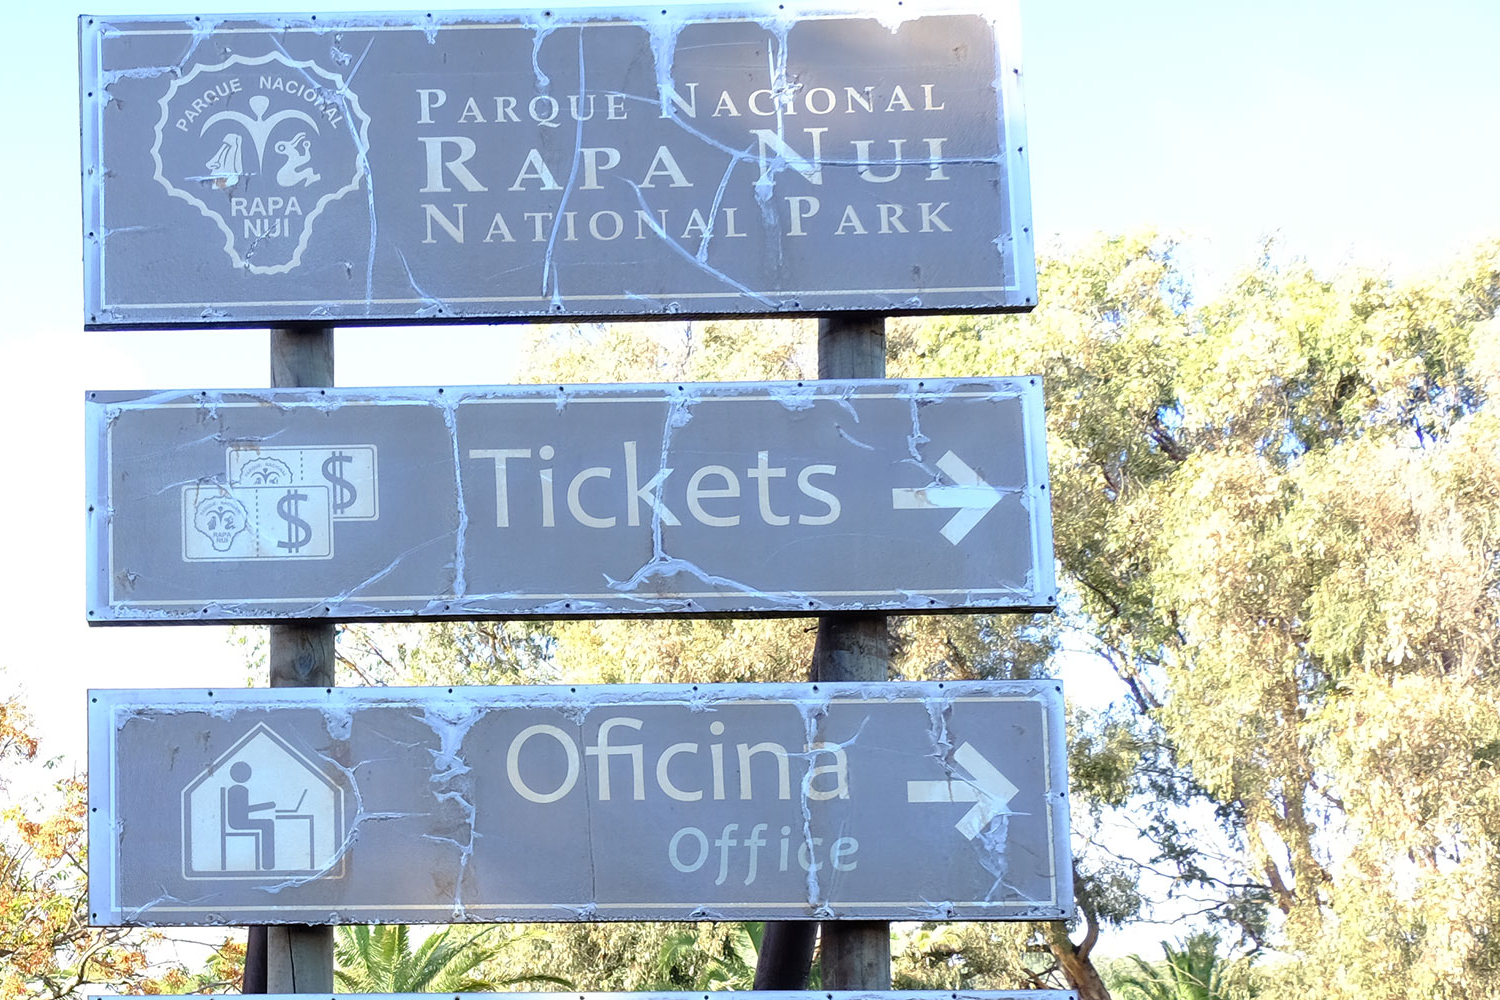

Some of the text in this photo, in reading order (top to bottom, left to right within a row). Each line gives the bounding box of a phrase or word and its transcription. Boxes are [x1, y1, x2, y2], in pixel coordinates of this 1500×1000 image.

[176, 78, 243, 132] PARQUE
[416, 88, 629, 128] PARQUE
[418, 127, 951, 193] RAPA NUI
[231, 196, 302, 217] RAPA
[244, 218, 290, 239] NUI
[421, 196, 953, 244] NATIONAL PARK
[469, 441, 842, 529] Tickets
[506, 717, 851, 804] Oficina
[668, 823, 860, 886] Office
